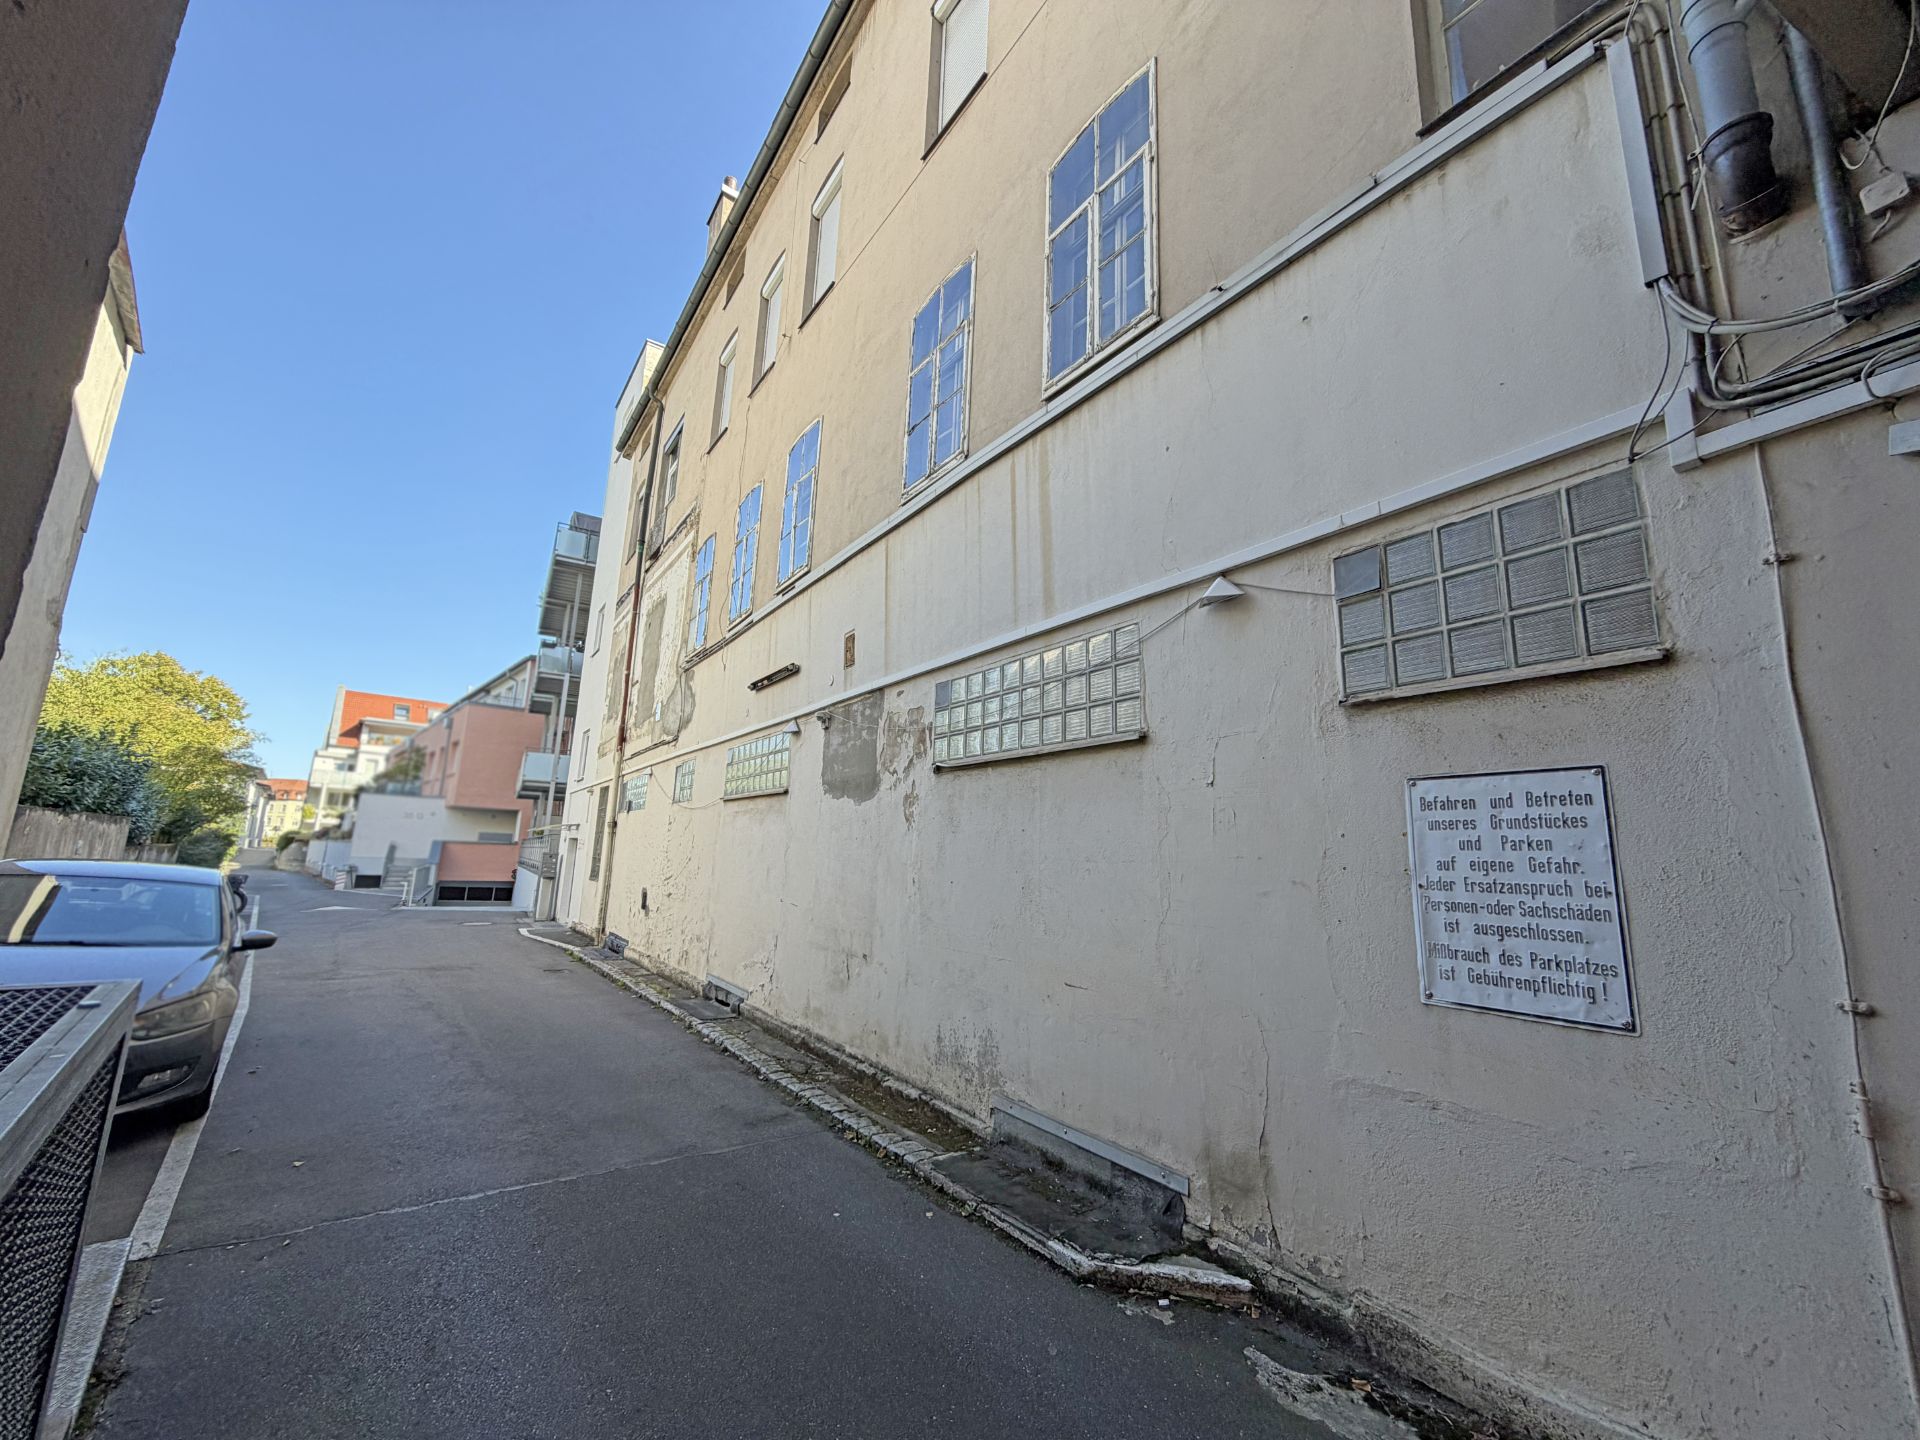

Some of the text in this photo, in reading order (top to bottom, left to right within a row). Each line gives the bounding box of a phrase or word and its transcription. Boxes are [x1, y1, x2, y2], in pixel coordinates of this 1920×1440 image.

[1419, 790, 1594, 812] Befahren und Betreten
[1427, 812, 1588, 831] unseres Grundstückes
[1458, 834, 1553, 852] und Parken
[1436, 855, 1586, 877] auf eigene Gefahr.
[1424, 875, 1456, 892] Jeder
[1464, 876, 1573, 902] Ersatzanspruch
[1519, 899, 1612, 923] Sachschäden
[1443, 917, 1590, 945] ist ausgeschlossen.
[1427, 940, 1619, 978] Mißbrauch des Parkplatzes
[1438, 964, 1456, 981] ist
